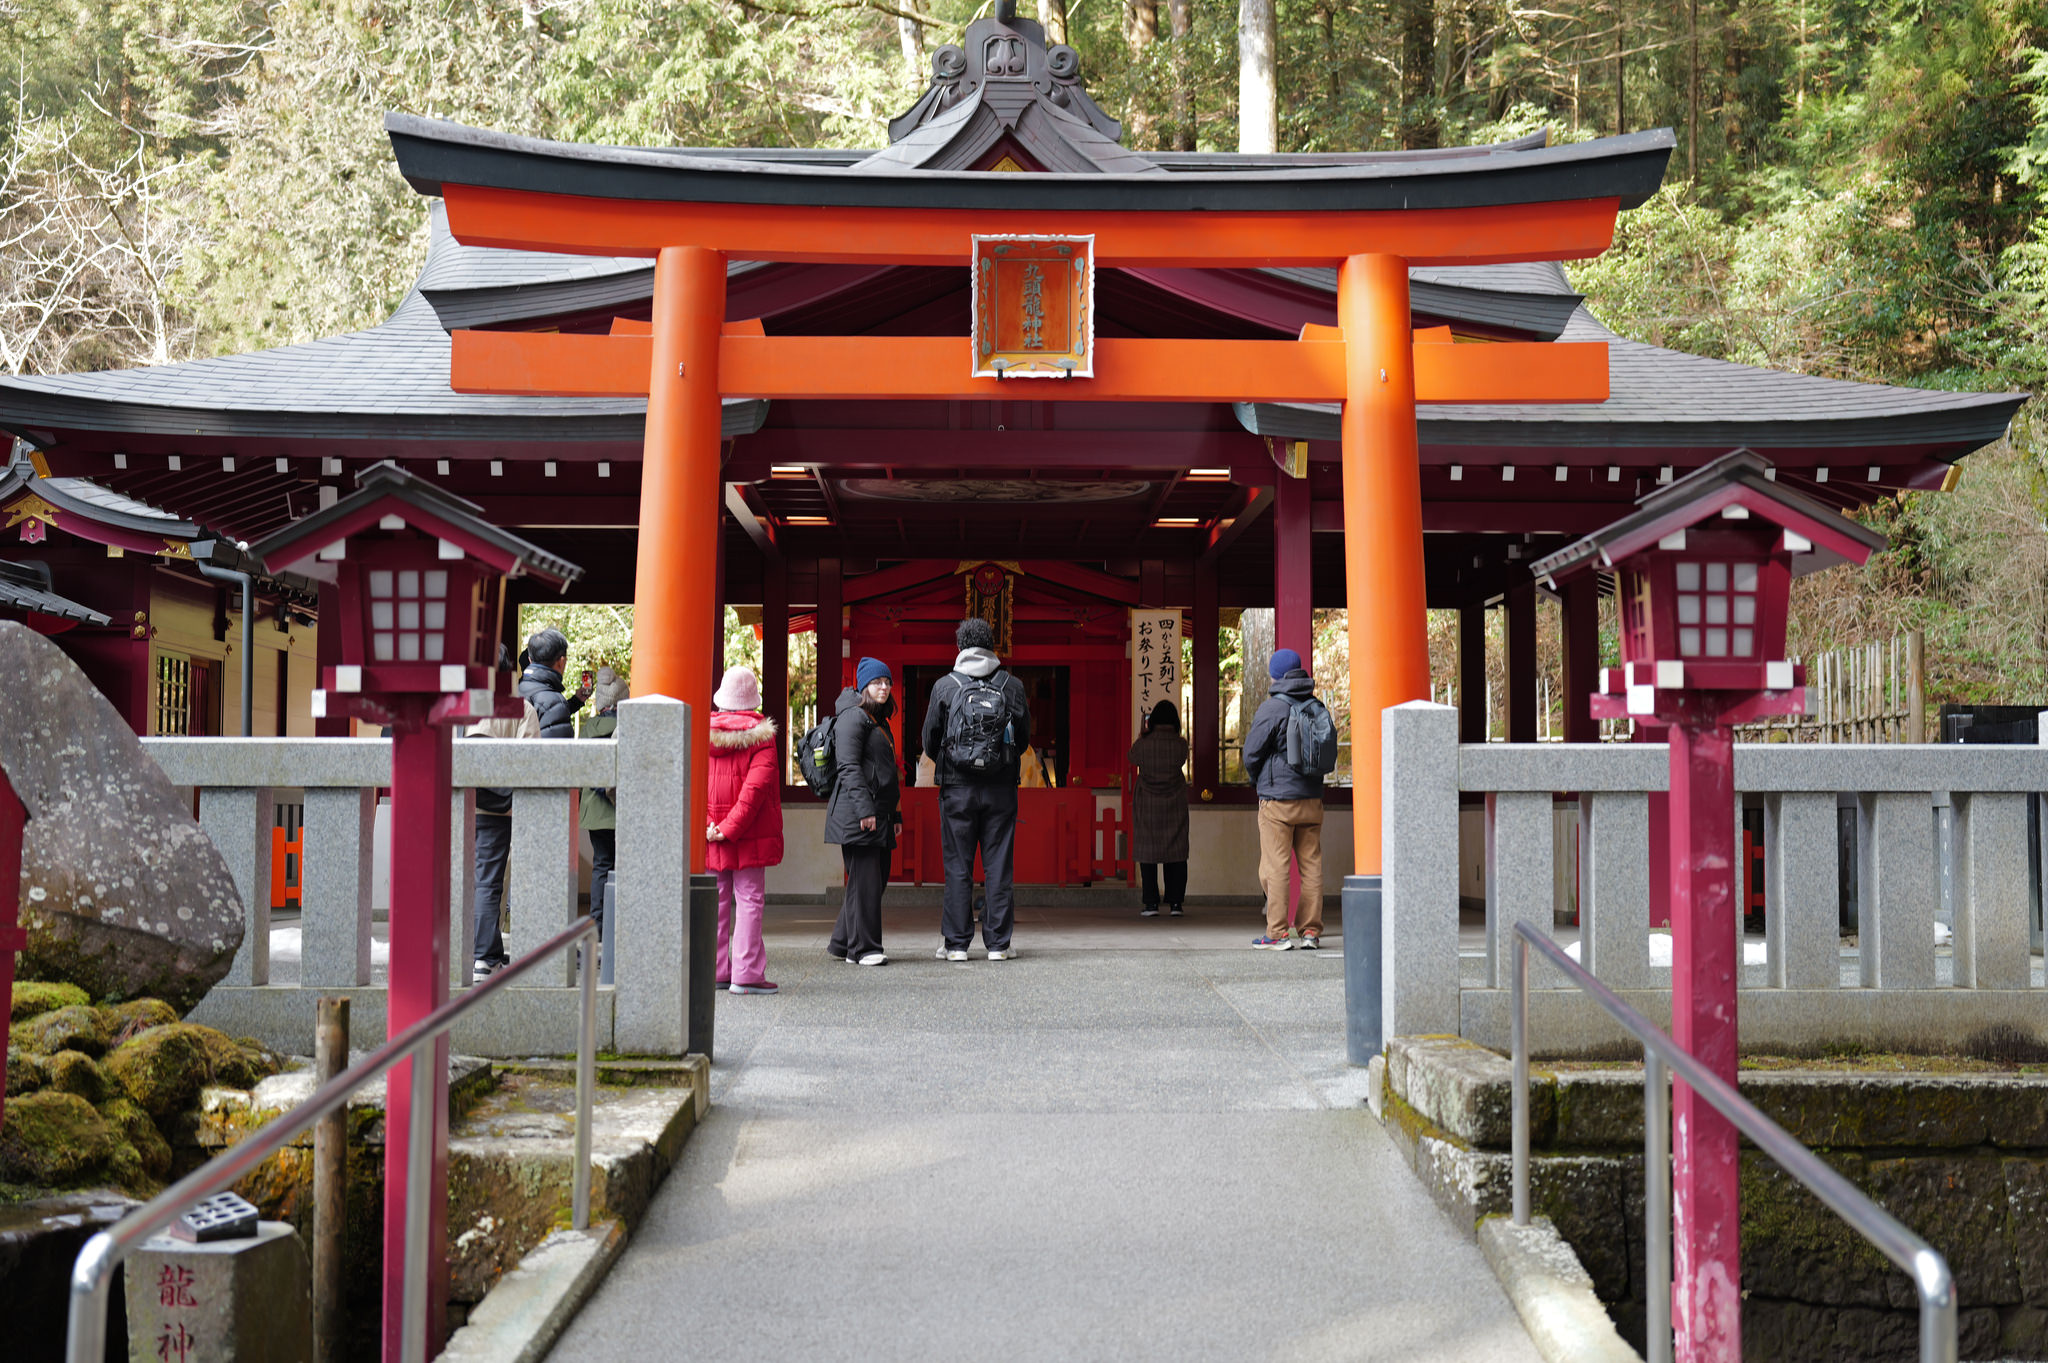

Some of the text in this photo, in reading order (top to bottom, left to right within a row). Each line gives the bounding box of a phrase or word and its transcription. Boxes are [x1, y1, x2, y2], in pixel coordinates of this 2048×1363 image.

[1022, 263, 1045, 348] 九頭龍神社
[156, 1264, 198, 1363] 龍神
